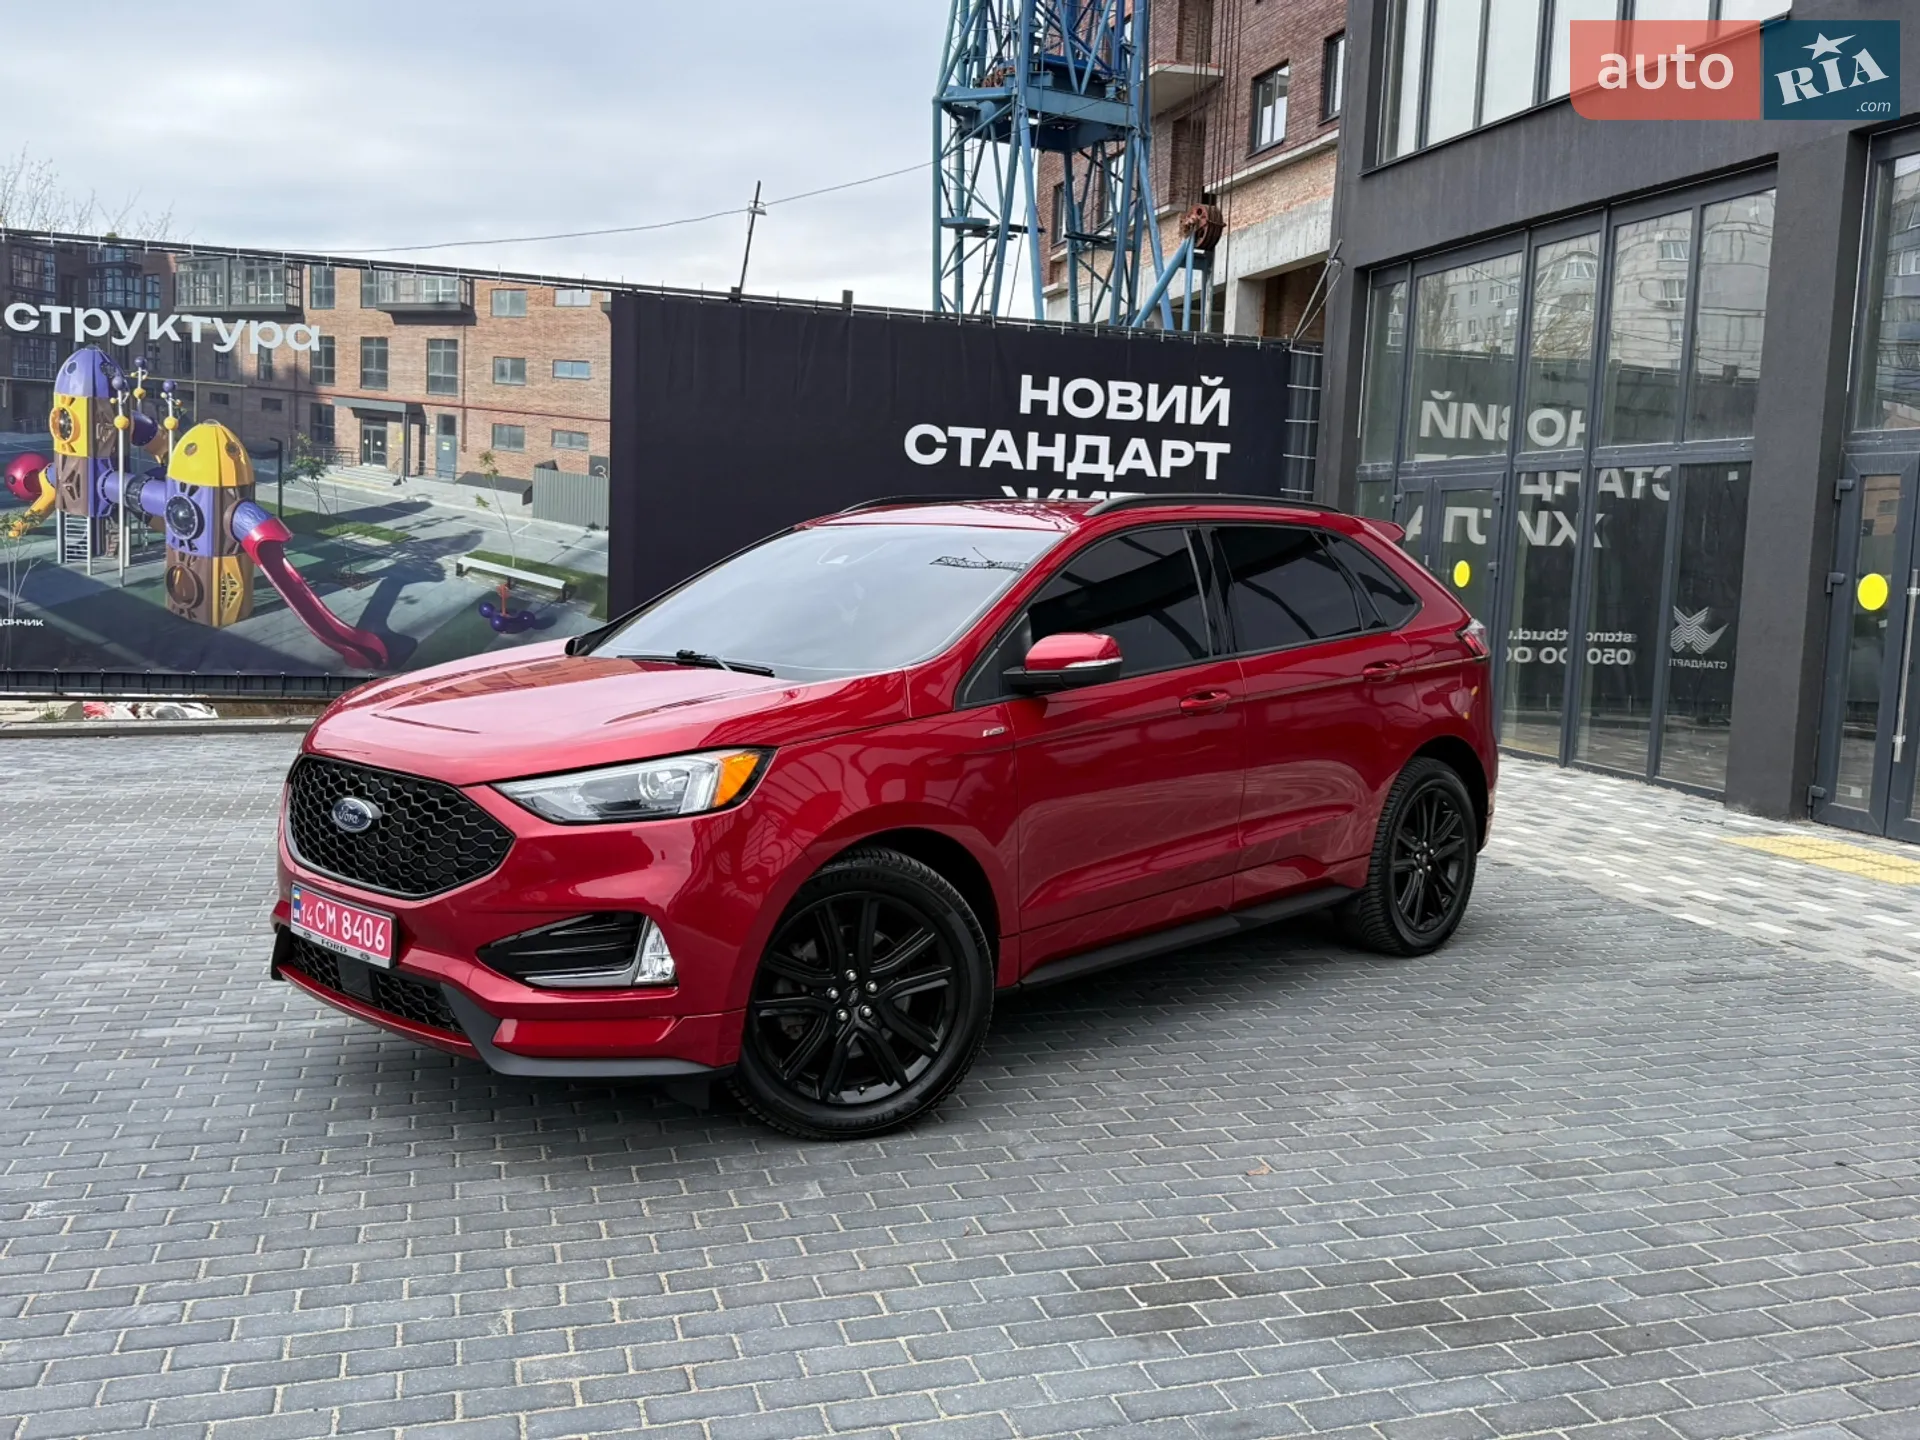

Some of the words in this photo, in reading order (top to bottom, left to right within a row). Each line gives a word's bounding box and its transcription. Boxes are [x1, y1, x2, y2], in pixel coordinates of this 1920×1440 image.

[4, 302, 320, 354] структура
[1019, 374, 1231, 427] НОВИЙ
[904, 423, 1231, 482] СТАНДАРТ
[320, 937, 348, 954] FORD
[341, 910, 385, 951] 8406
